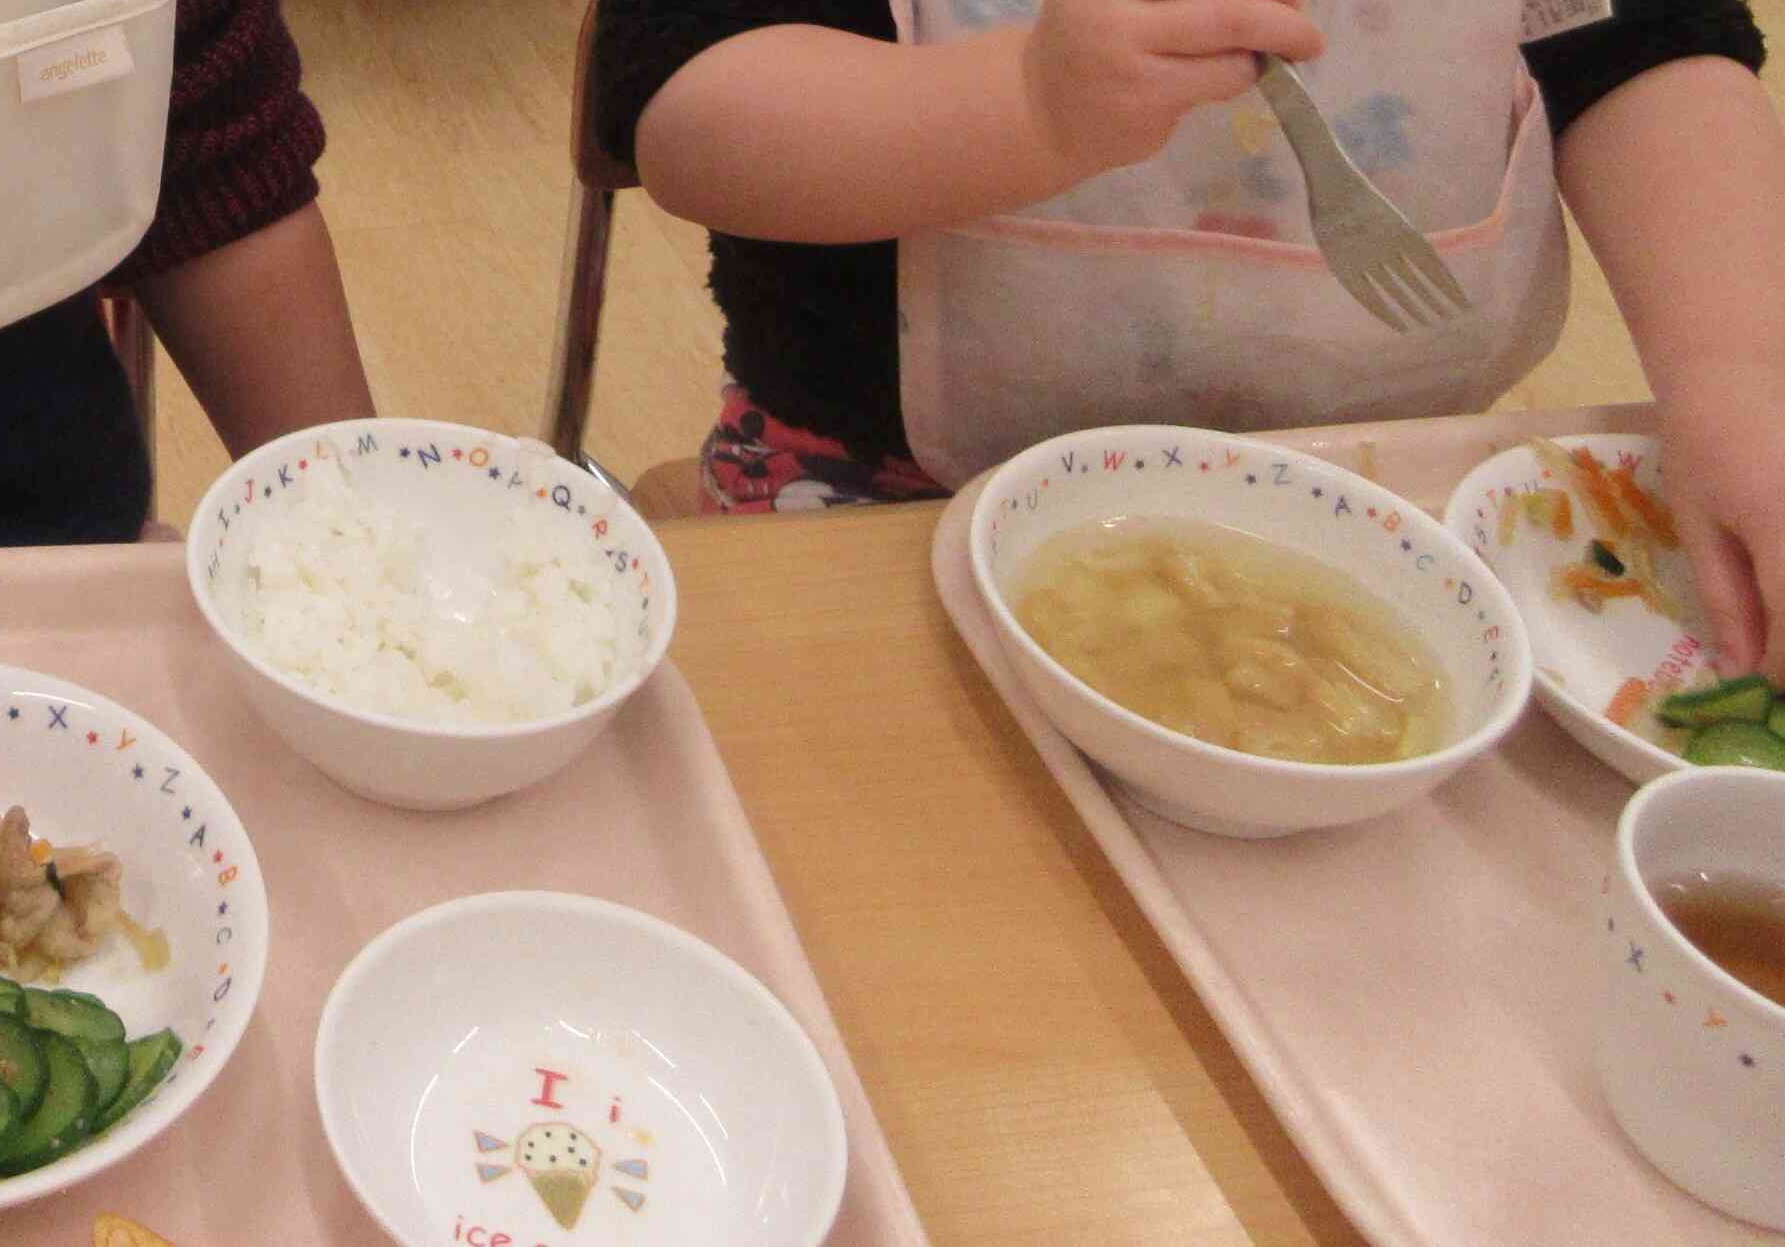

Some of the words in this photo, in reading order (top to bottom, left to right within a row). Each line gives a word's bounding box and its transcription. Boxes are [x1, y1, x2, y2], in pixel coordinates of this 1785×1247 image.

[245, 479, 255, 504] J
[278, 464, 294, 488] K
[356, 434, 379, 455] M
[418, 443, 441, 469] N
[469, 448, 489, 466] O
[552, 485, 571, 511] Q
[592, 519, 608, 540] R
[616, 552, 628, 573] S
[1027, 489, 1038, 510] U
[1061, 452, 1073, 473] V
[1104, 450, 1127, 471] W
[1162, 446, 1182, 467] X
[1272, 464, 1290, 484] Z
[1335, 496, 1351, 518] A
[1384, 511, 1402, 531] B
[1416, 554, 1434, 571] C
[1457, 581, 1472, 604] D
[48, 705, 68, 729] X
[117, 729, 136, 750] Y
[160, 768, 180, 793] Z
[190, 825, 206, 848] A
[219, 866, 238, 884] B
[217, 927, 232, 945] C
[530, 1067, 569, 1109] I
[454, 1214, 512, 1247] ice
